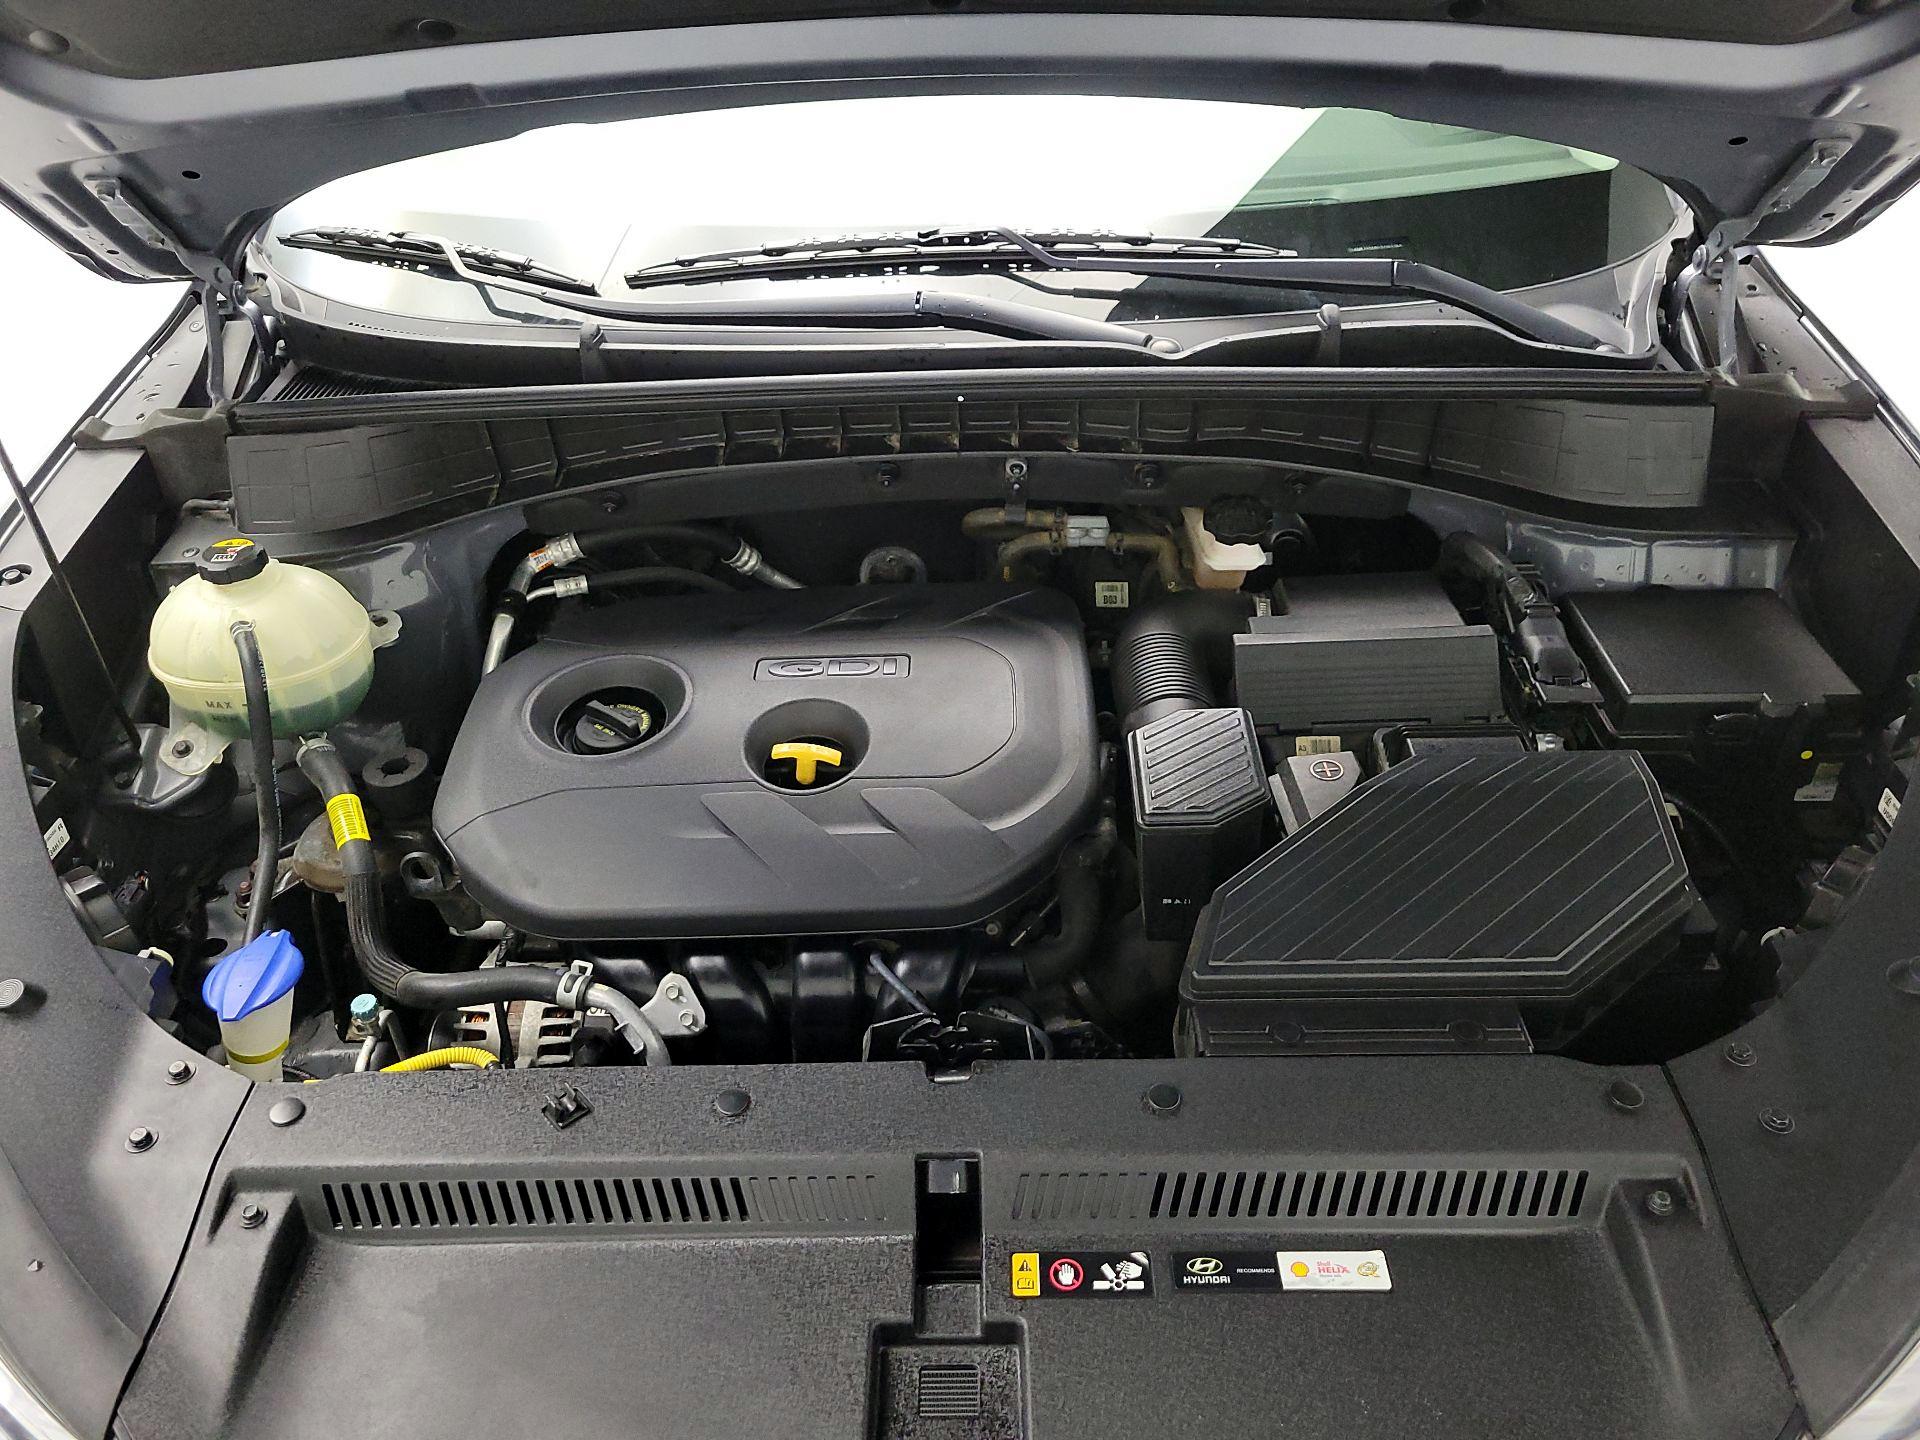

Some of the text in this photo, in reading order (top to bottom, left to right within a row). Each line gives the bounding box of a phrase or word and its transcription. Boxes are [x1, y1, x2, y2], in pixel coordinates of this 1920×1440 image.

[768, 658, 898, 677] GDI
[205, 700, 232, 710] MAX
[1317, 1265, 1350, 1274] HELIX
[1183, 1275, 1231, 1284] HYUNDAI
